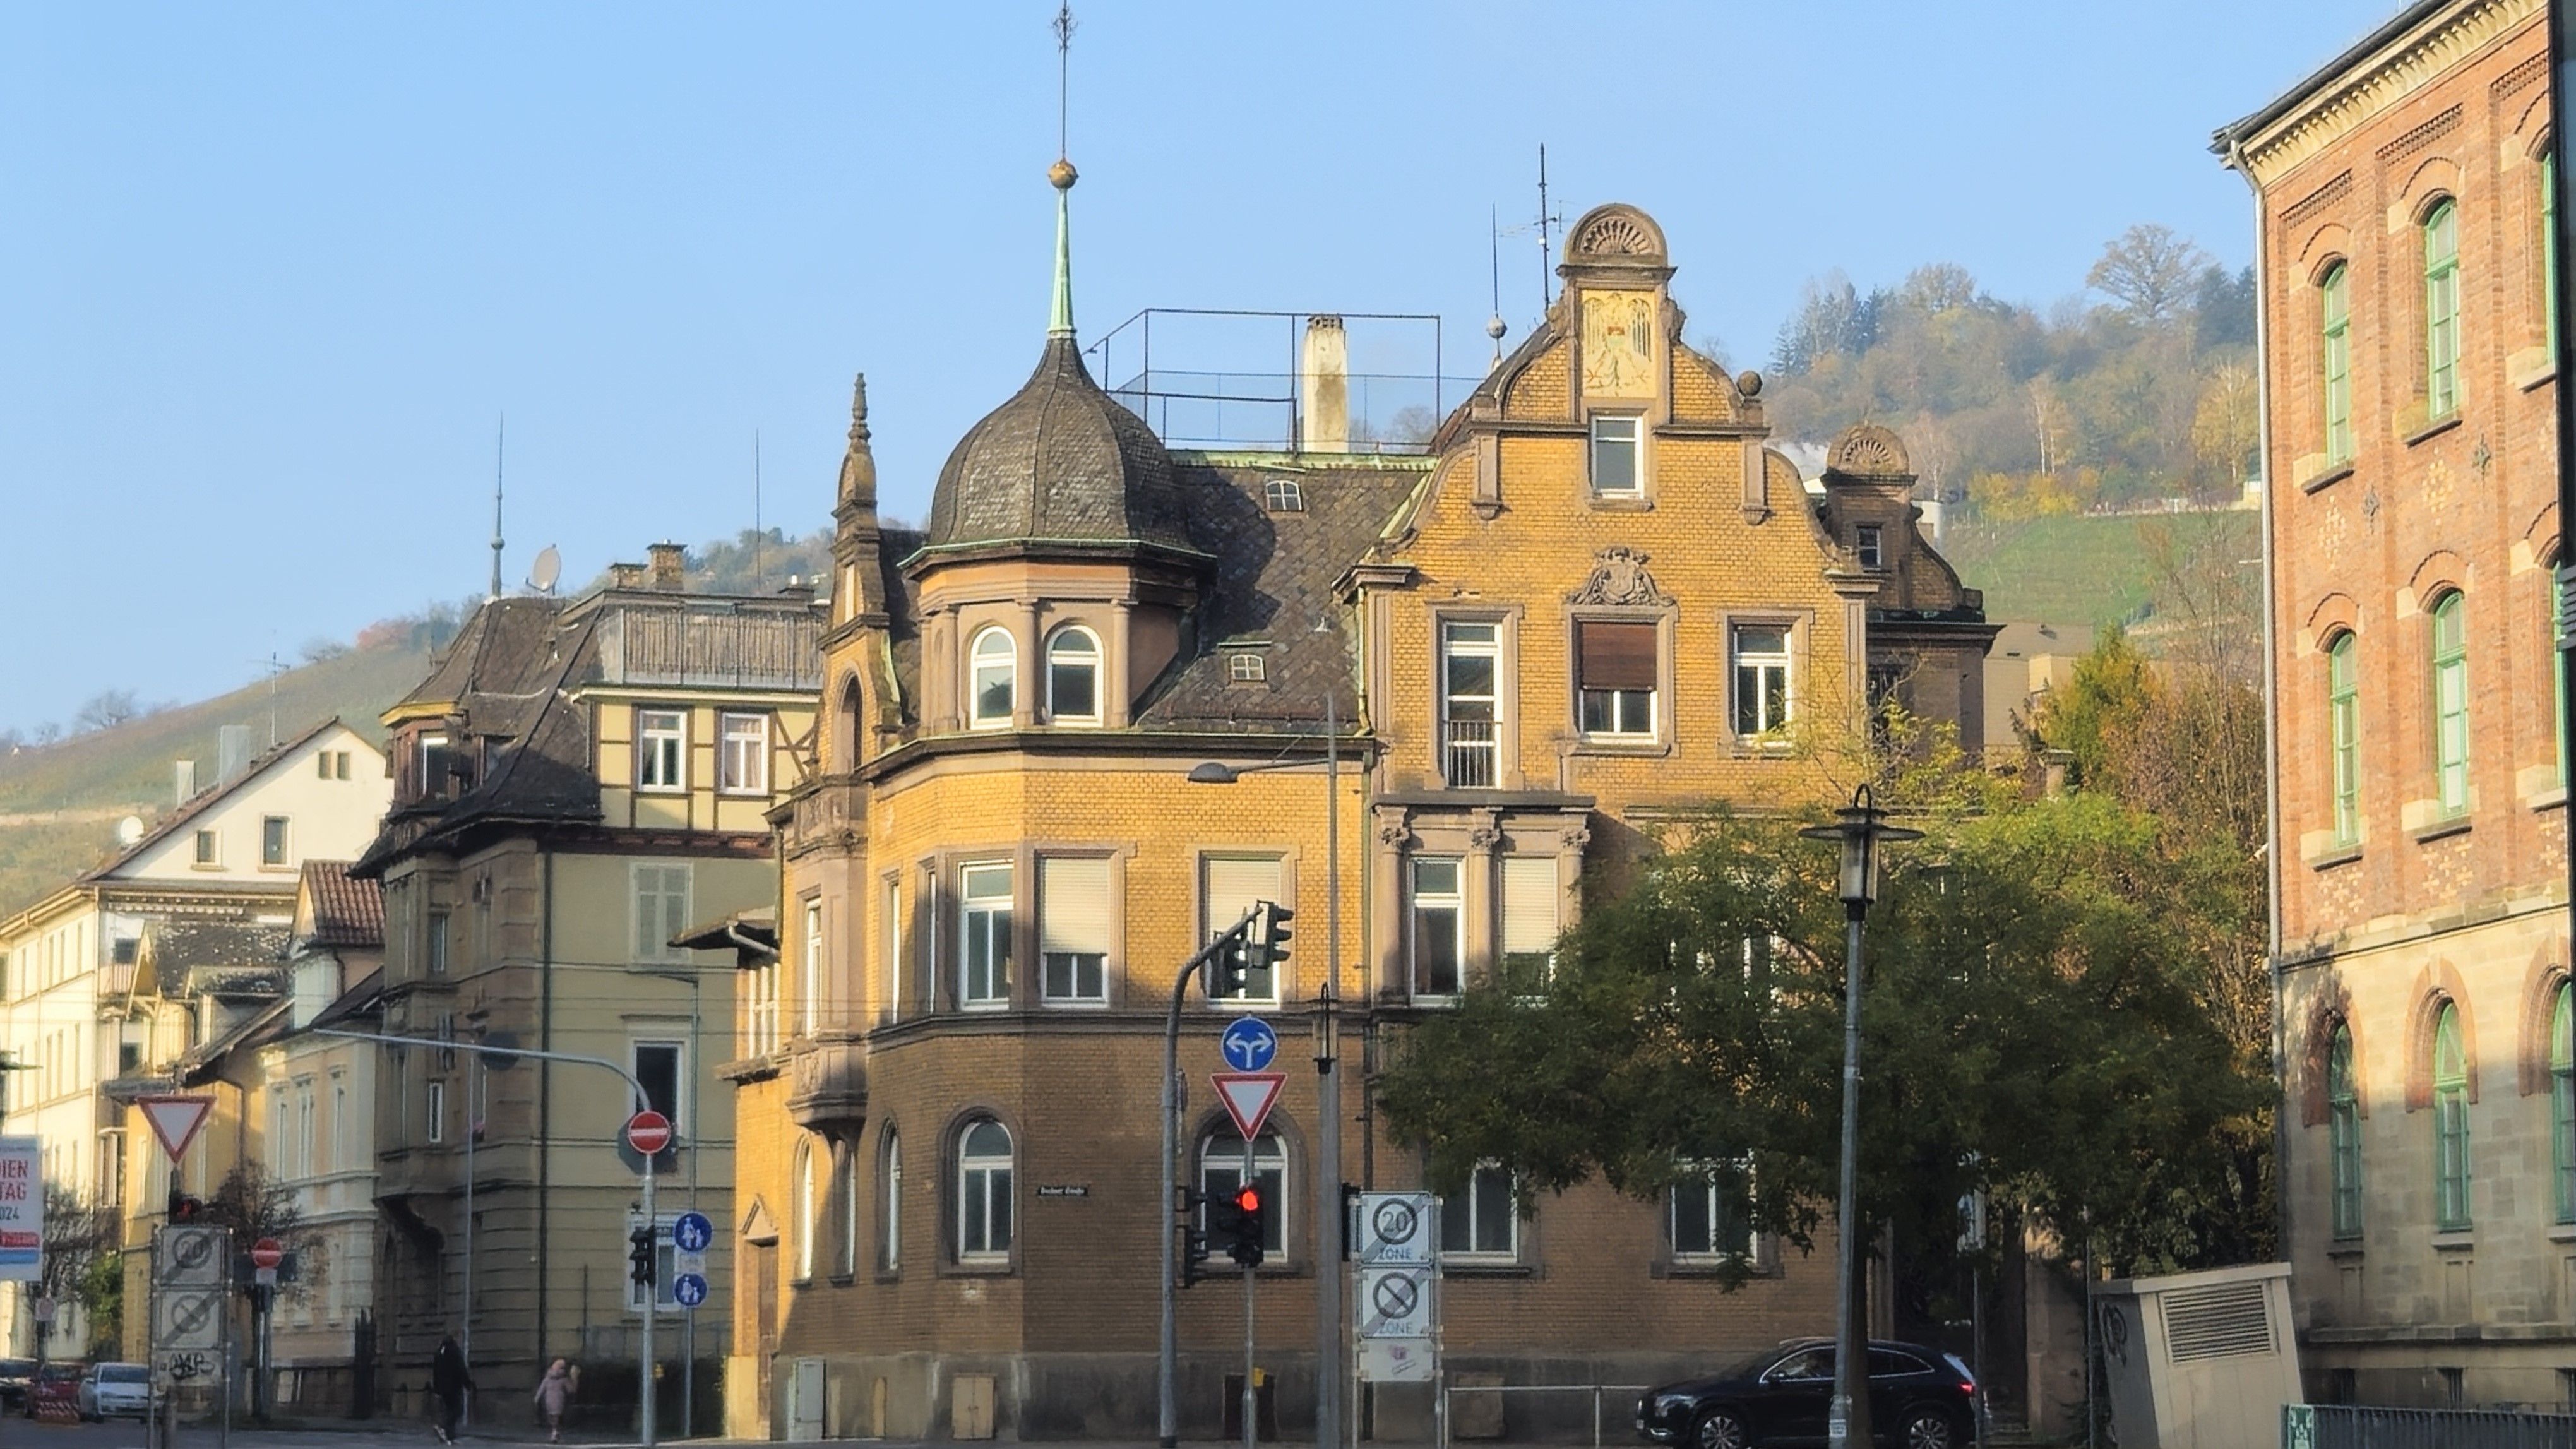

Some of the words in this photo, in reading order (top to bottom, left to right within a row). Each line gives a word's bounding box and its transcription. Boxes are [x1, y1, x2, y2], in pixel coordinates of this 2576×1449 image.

[0, 1160, 27, 1178] IEN
[1383, 1211, 1407, 1232] 20
[1379, 1247, 1412, 1260] ZONE
[1379, 1322, 1413, 1334] ZONE
